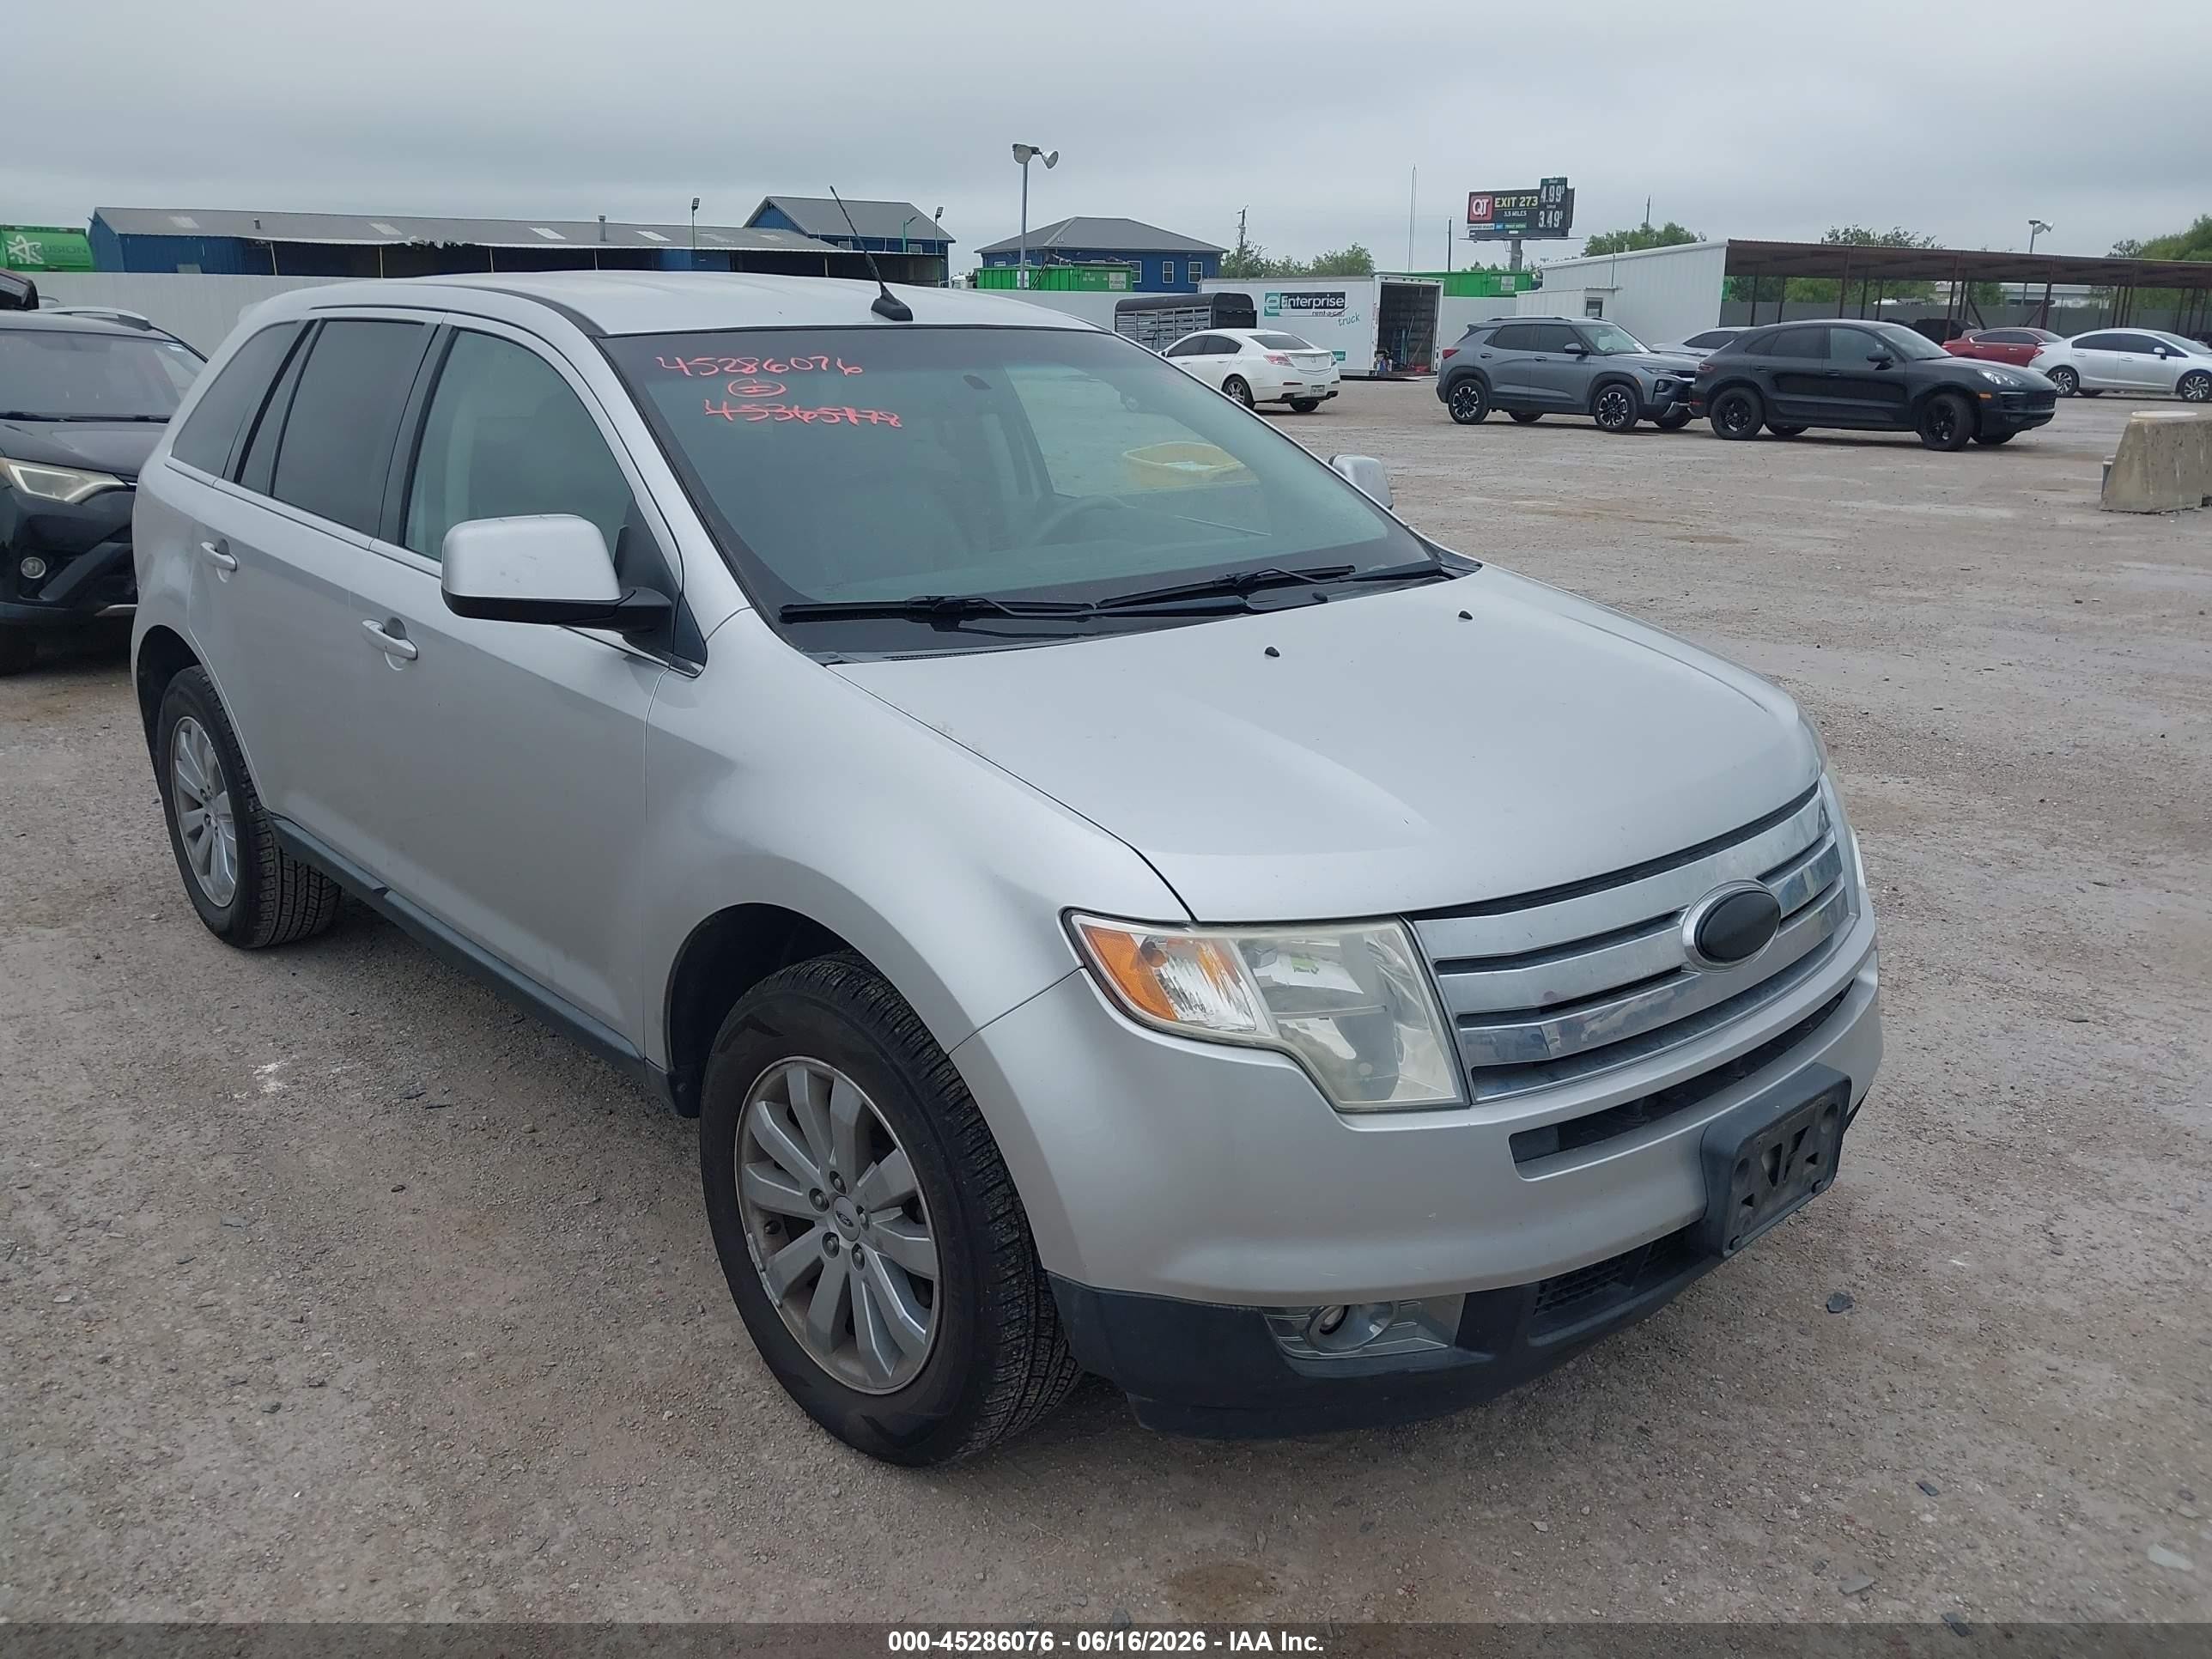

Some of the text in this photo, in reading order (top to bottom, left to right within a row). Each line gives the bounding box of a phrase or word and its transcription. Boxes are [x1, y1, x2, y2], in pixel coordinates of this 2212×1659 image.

[1472, 198, 1489, 217] QT
[1494, 196, 1539, 208] EXIT 273
[1281, 294, 1345, 309] Enterprise
[1338, 313, 1360, 326] truck
[656, 356, 863, 376] 45286076
